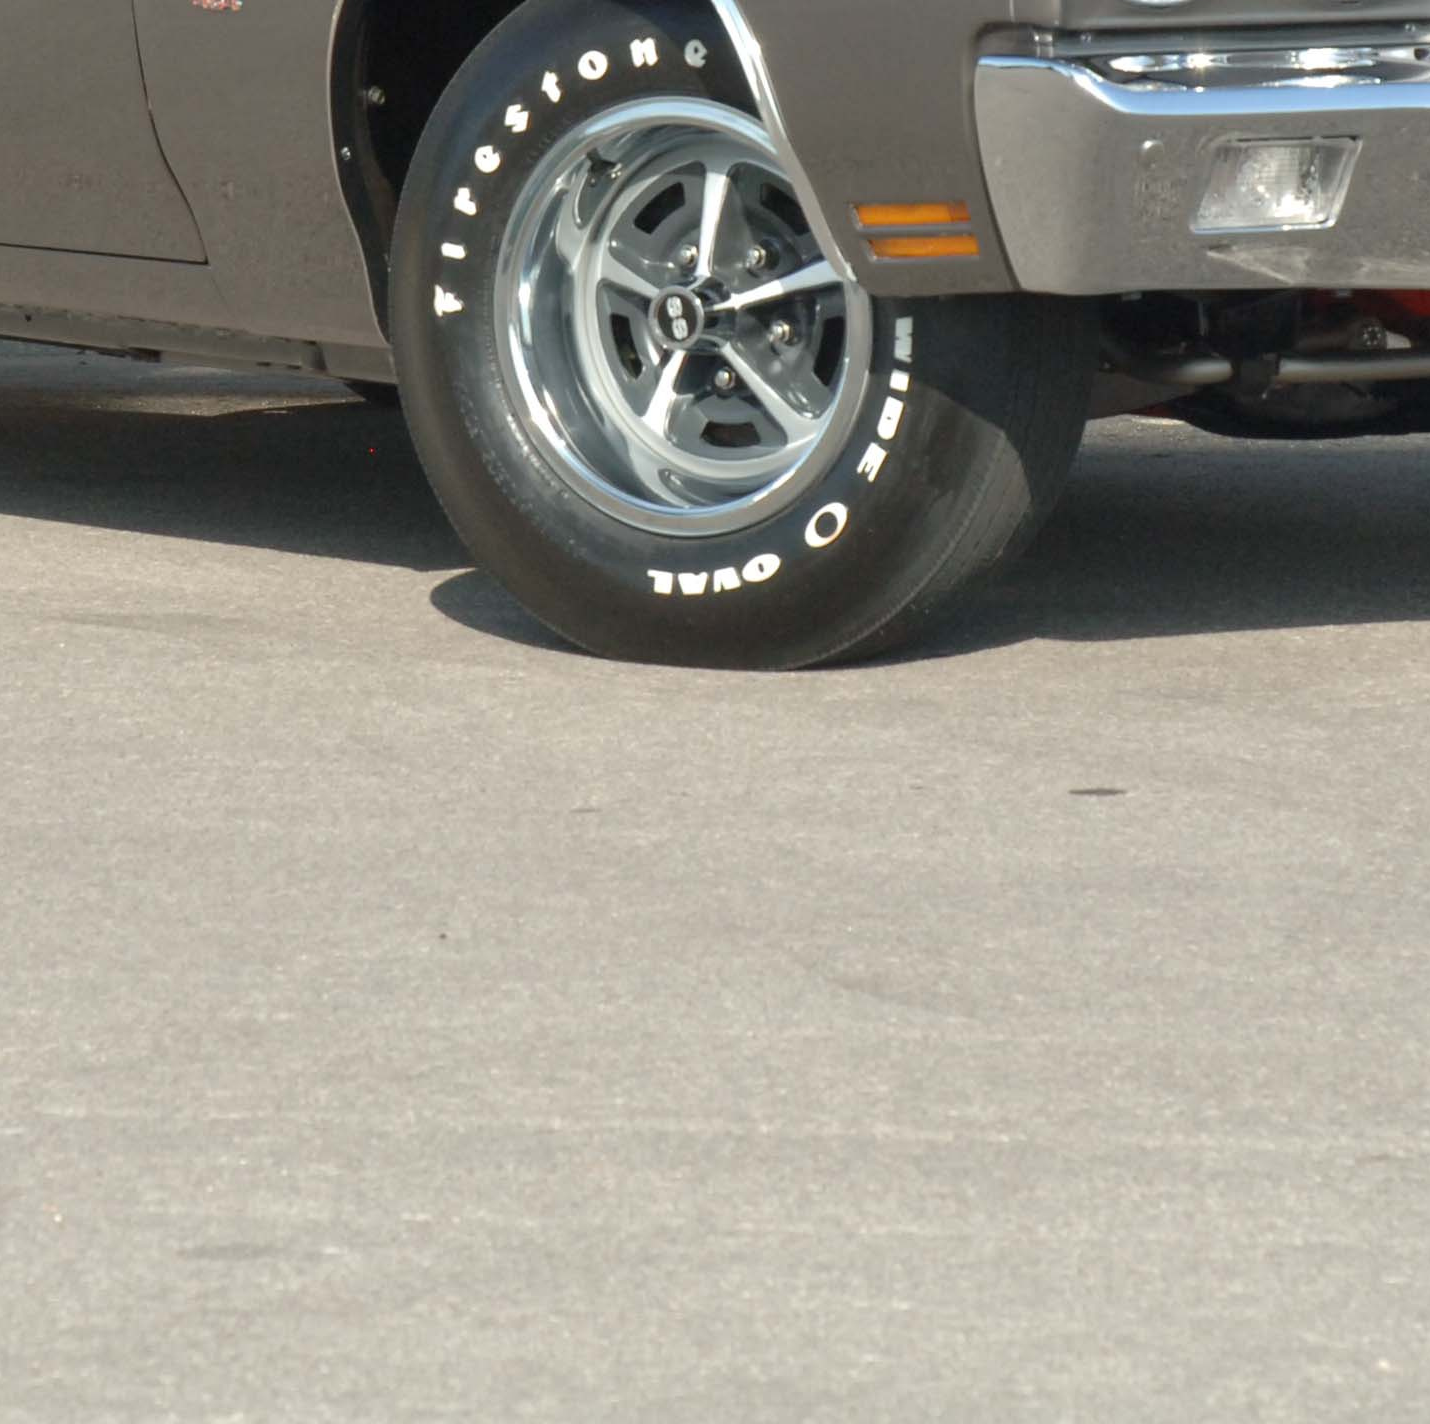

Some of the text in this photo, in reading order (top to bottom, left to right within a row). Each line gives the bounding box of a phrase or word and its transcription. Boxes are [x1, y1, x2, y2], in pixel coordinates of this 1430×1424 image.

[433, 37, 708, 317] Firestone
[856, 316, 914, 483] WIDE
[646, 553, 782, 596] OVAL
